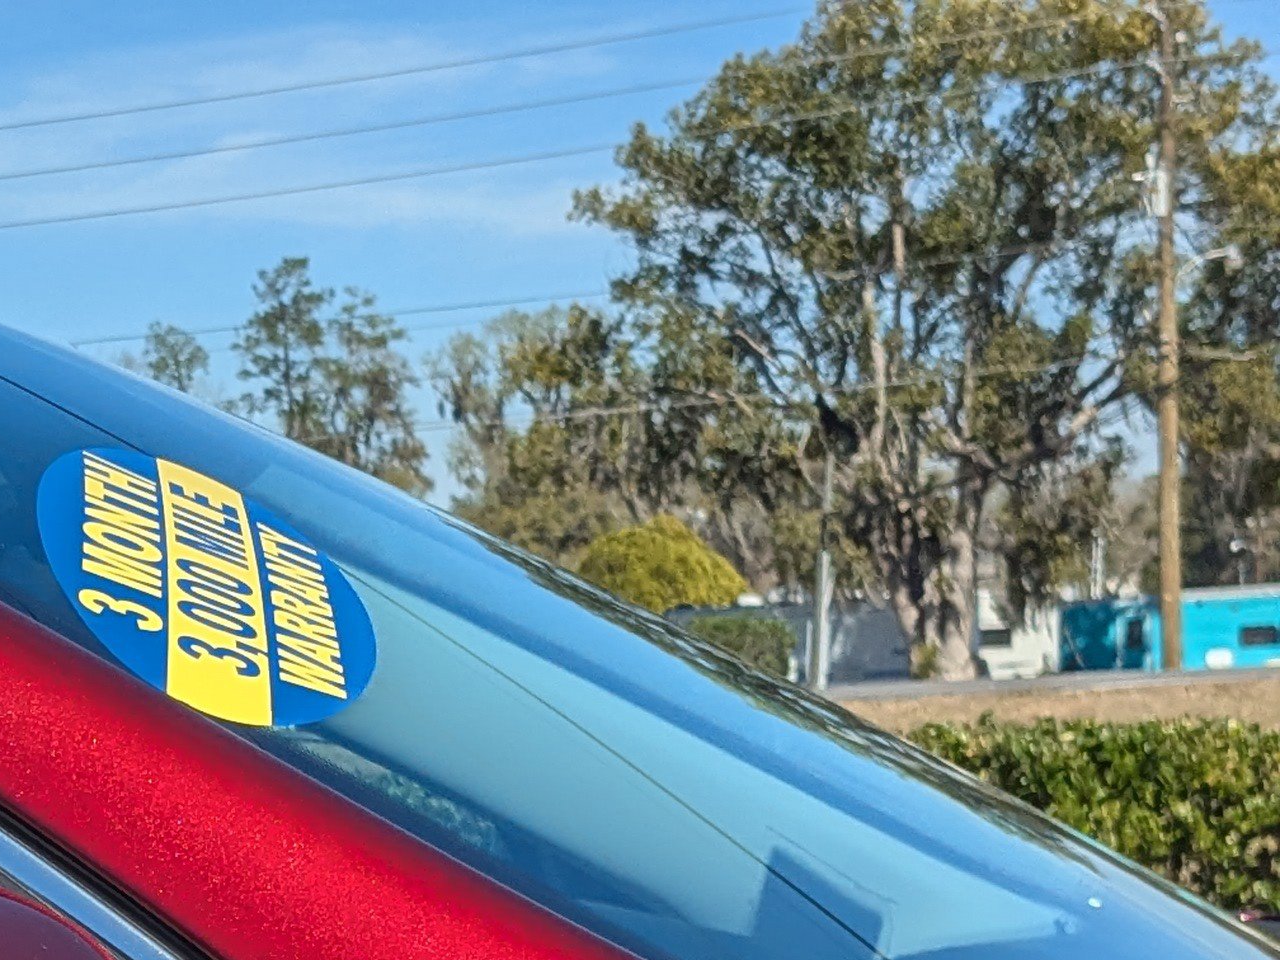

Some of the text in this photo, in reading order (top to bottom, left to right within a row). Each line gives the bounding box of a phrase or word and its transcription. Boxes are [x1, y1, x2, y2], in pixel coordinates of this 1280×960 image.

[79, 450, 163, 632] 3 MONTH
[169, 482, 268, 677] 3,000 MILE
[256, 522, 347, 699] WARRANTY
